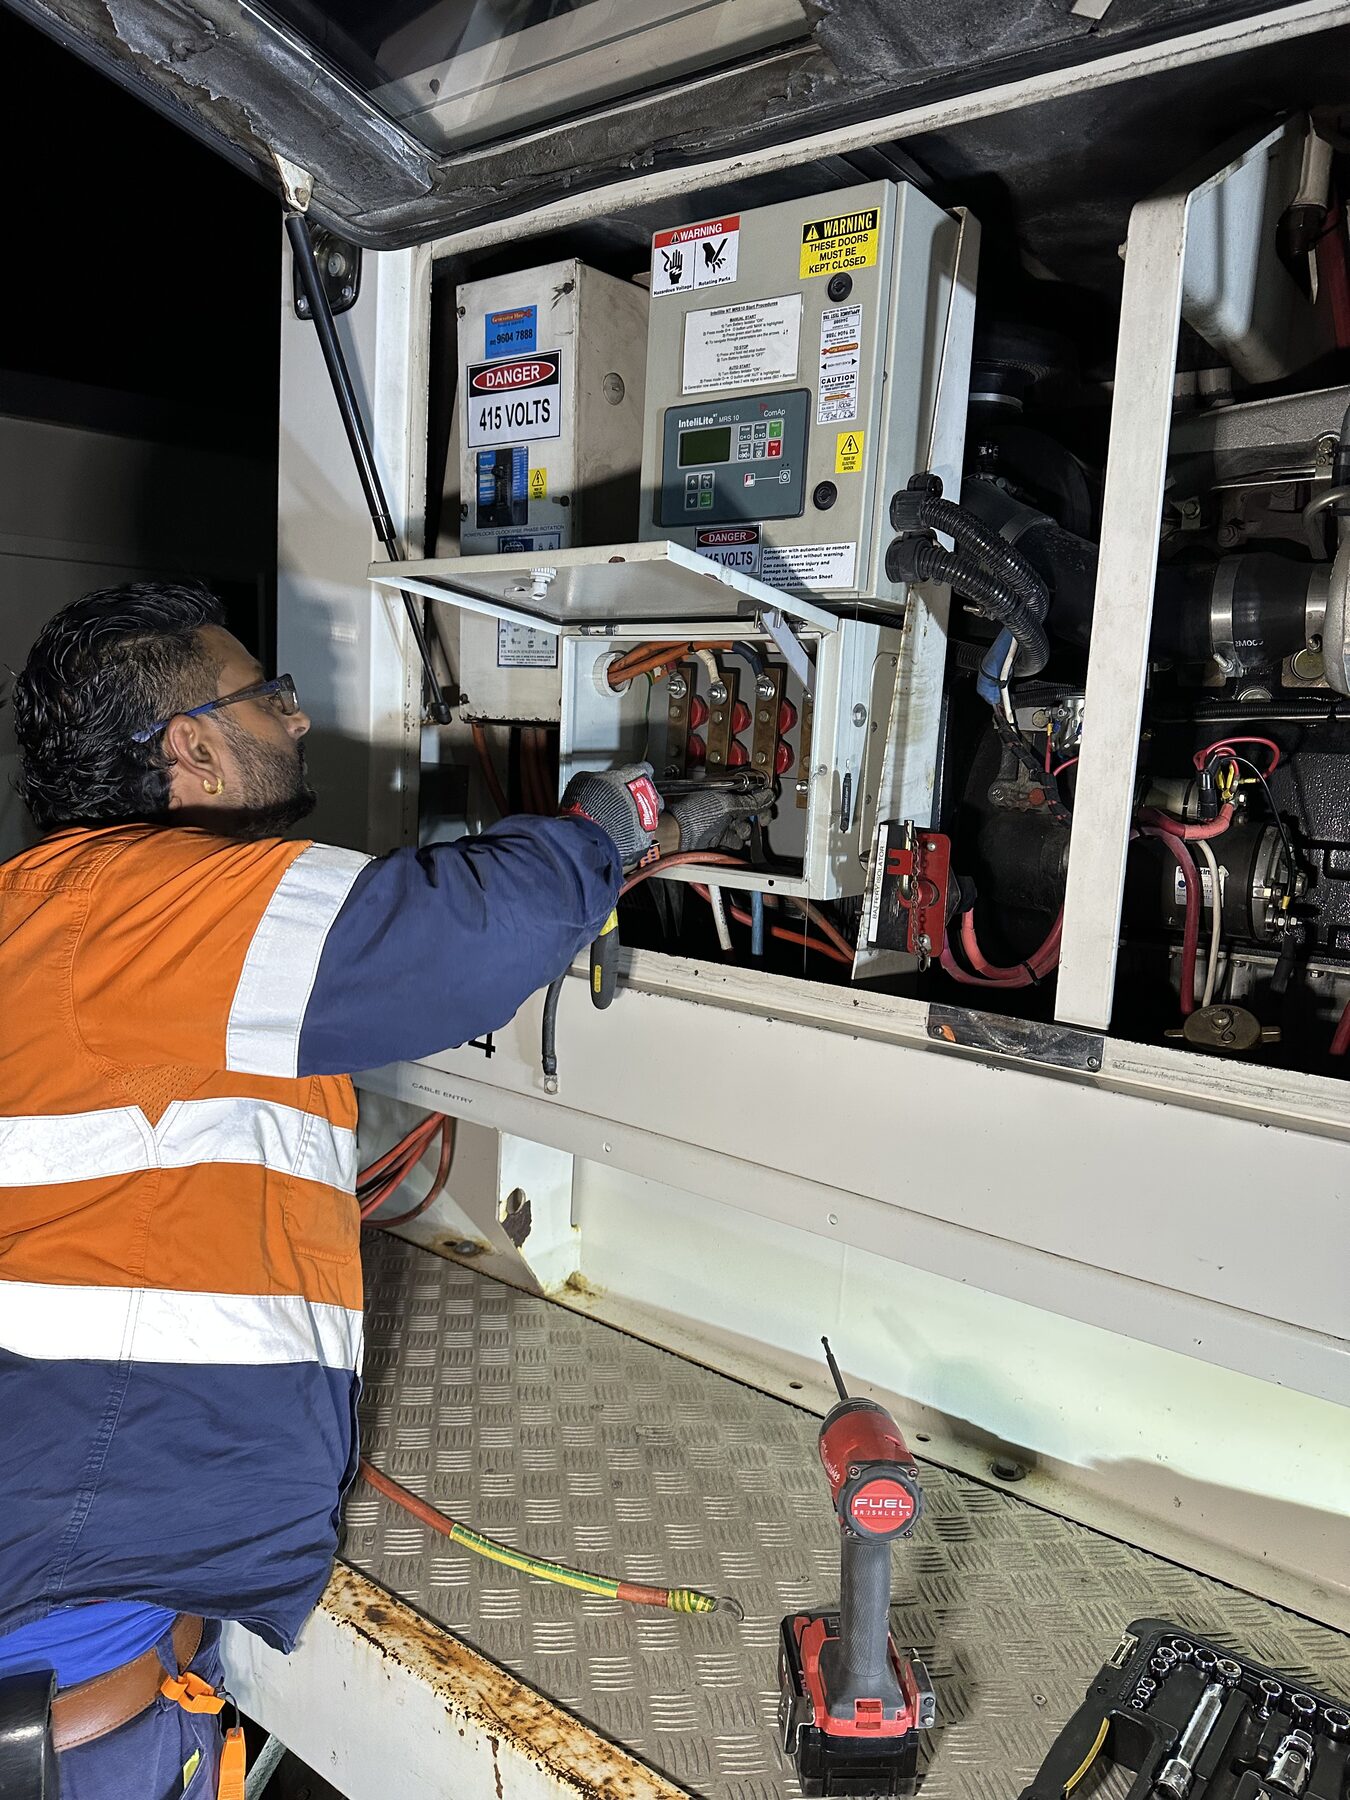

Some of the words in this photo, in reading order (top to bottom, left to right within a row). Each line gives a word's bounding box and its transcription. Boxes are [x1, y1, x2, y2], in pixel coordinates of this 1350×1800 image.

[680, 223, 722, 240] WARNING
[824, 214, 873, 238] WARNING
[809, 239, 836, 253] THESE
[838, 233, 869, 247] DOORS
[819, 249, 843, 262] MUST
[845, 246, 856, 258] BE
[808, 261, 830, 274] KEPT
[832, 255, 866, 270] CLOSED
[654, 287, 676, 296] Hazardous
[676, 284, 692, 292] Voltage
[497, 332, 514, 344] 9604
[516, 328, 532, 341] 7888
[486, 365, 540, 387] DANGER
[822, 374, 855, 384] CAUTION
[480, 406, 502, 431] 415
[505, 398, 550, 428] VOLTS
[764, 408, 786, 418] ComAp
[678, 416, 714, 428] InteliLite
[708, 532, 747, 543] DANGER
[722, 551, 752, 566] VOLTS
[872, 886, 880, 920] BATTERY
[876, 846, 886, 884] ISOLATOR
[468, 1032, 496, 1058] 4
[412, 1082, 440, 1095] CABLE
[443, 1092, 473, 1104] ENTRY
[854, 1498, 910, 1508] FUEL
